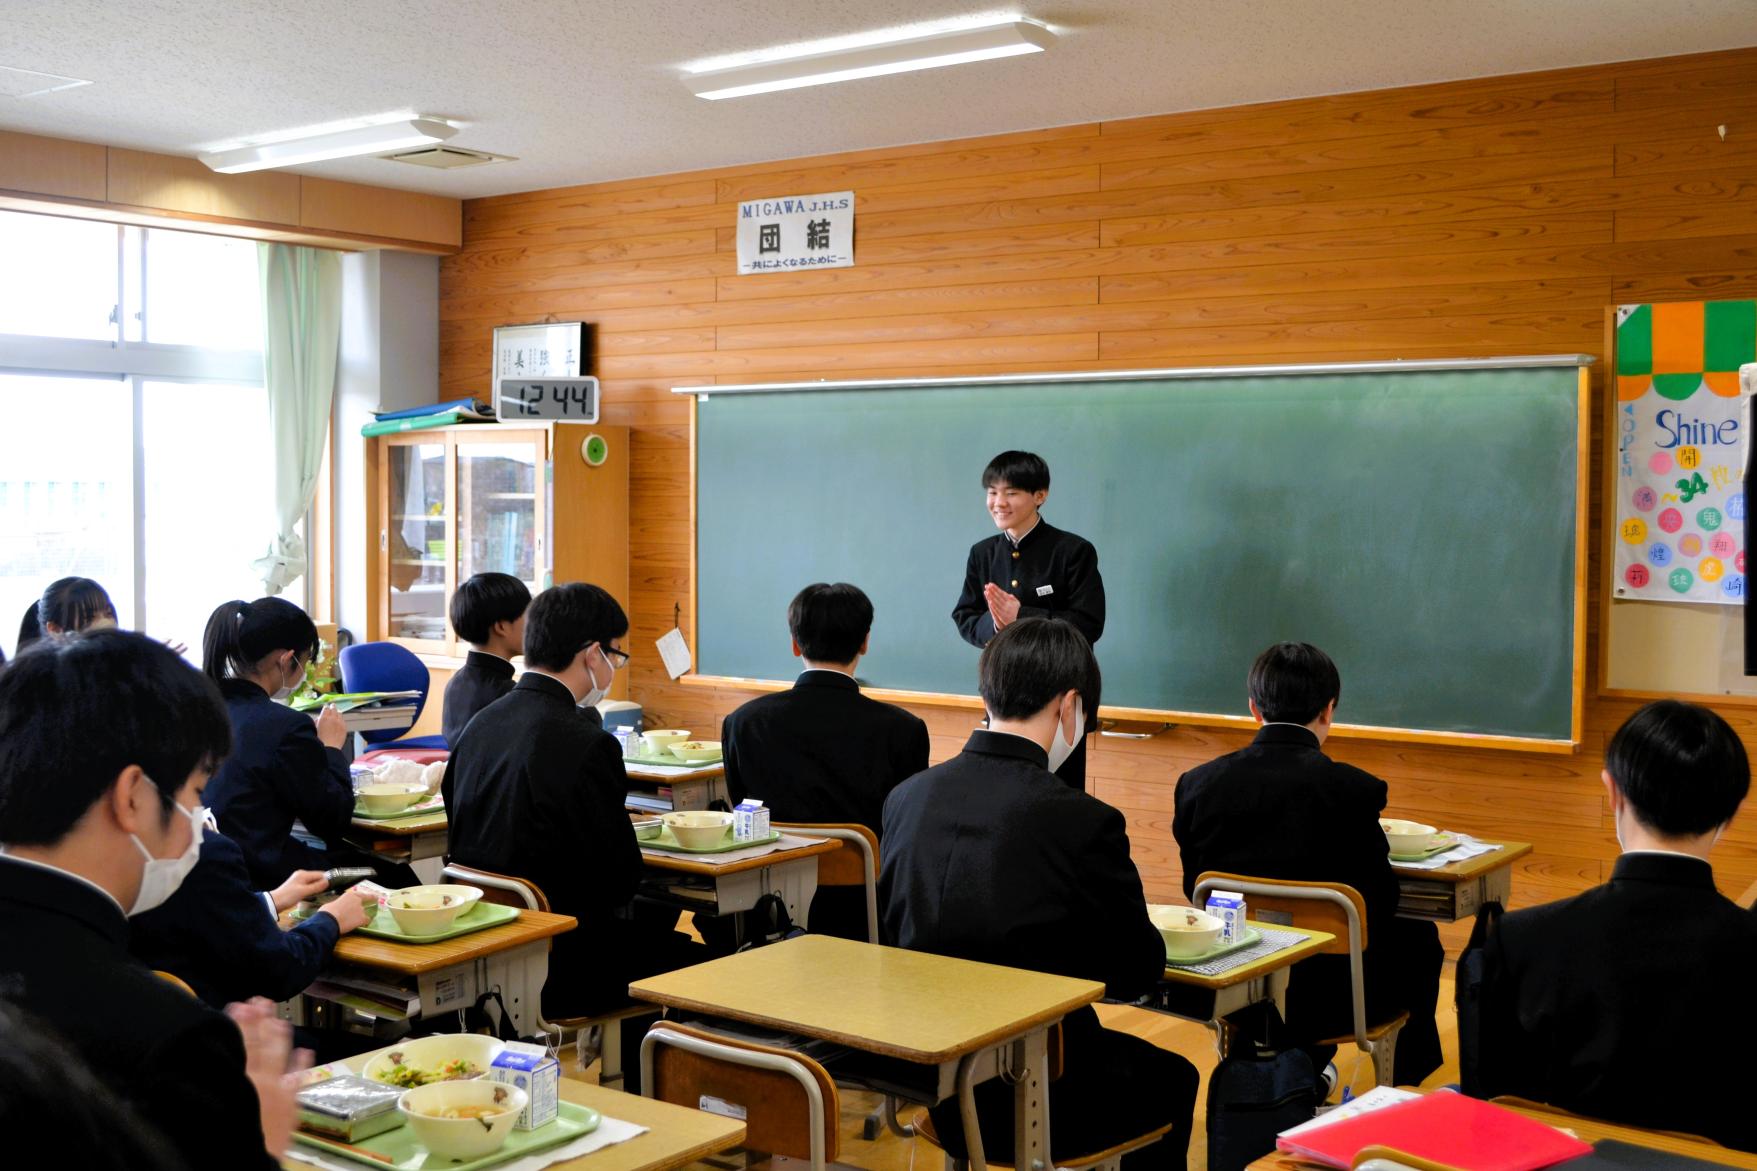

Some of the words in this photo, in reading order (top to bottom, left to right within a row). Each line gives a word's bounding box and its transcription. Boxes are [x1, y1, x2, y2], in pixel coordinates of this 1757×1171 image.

[742, 200, 805, 218] MIGAWA
[1622, 418, 1636, 477] OPEN
[1654, 409, 1739, 448] Shine
